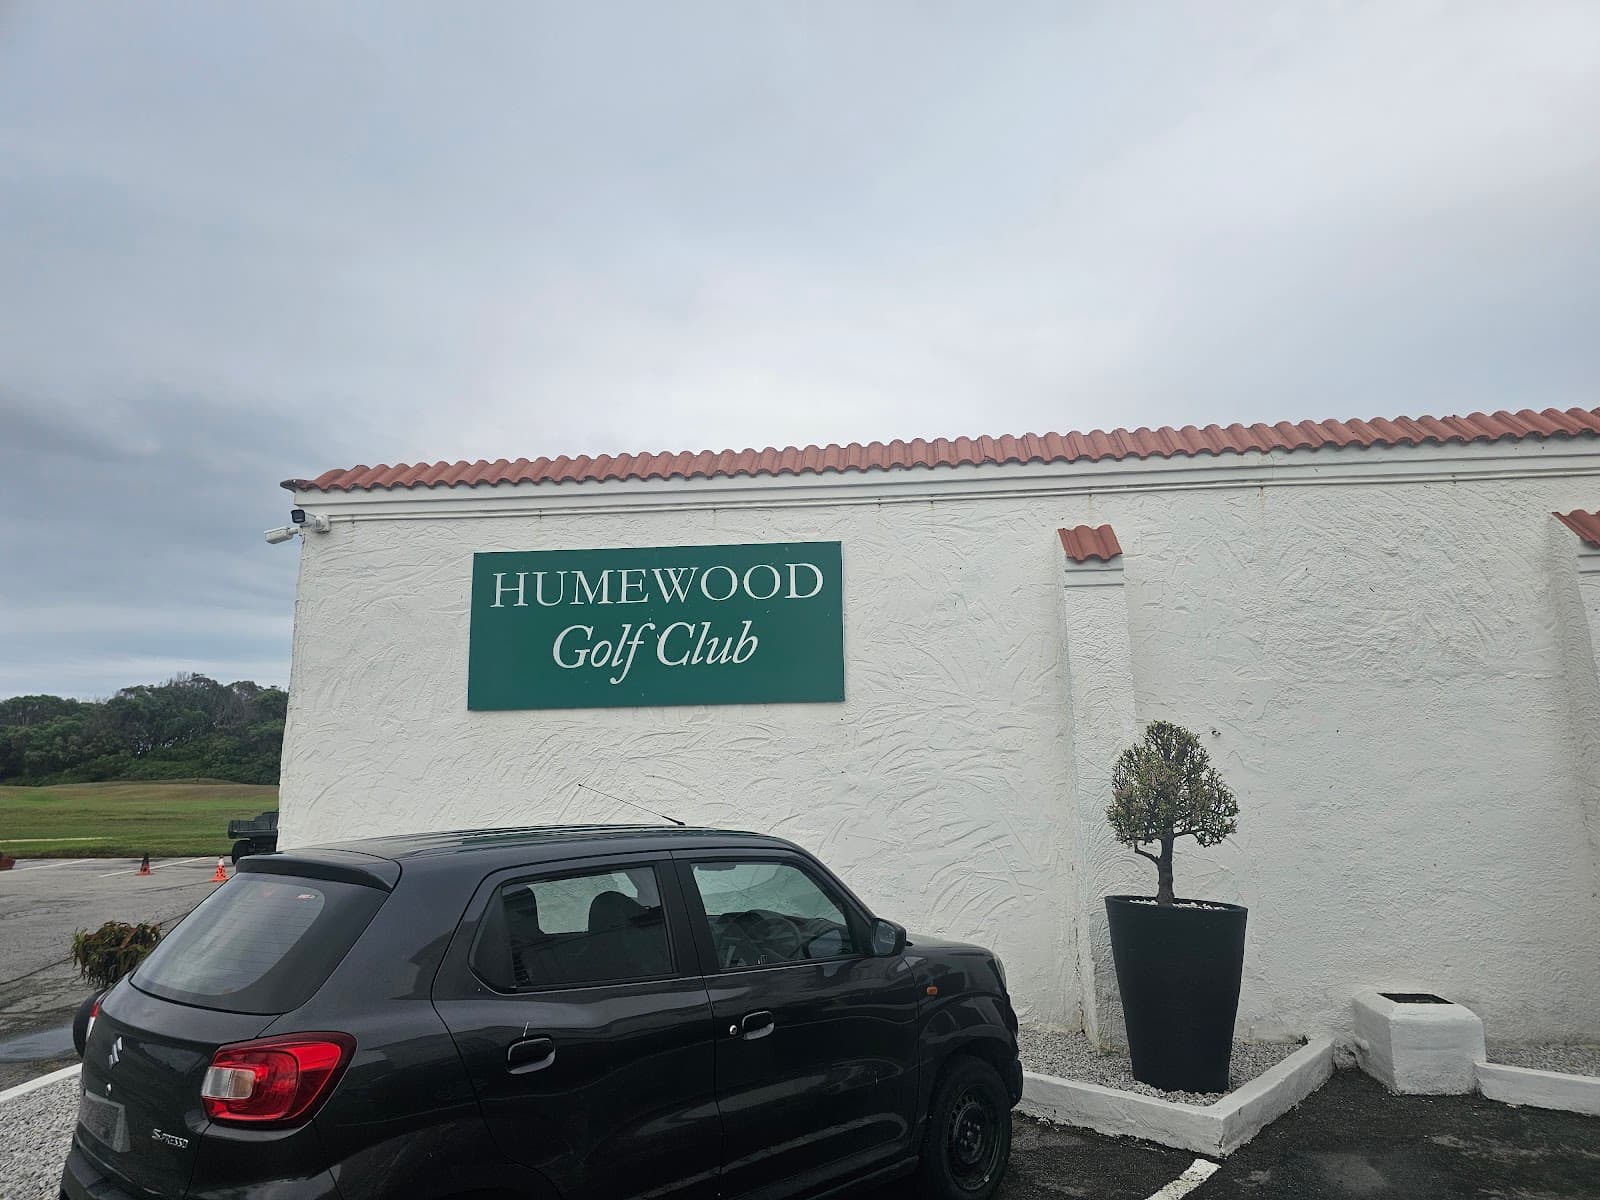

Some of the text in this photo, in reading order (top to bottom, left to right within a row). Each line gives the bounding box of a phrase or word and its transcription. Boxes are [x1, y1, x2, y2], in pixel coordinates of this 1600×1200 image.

[490, 562, 825, 608] HUMEWOOD
[551, 620, 759, 685] Golf Club
